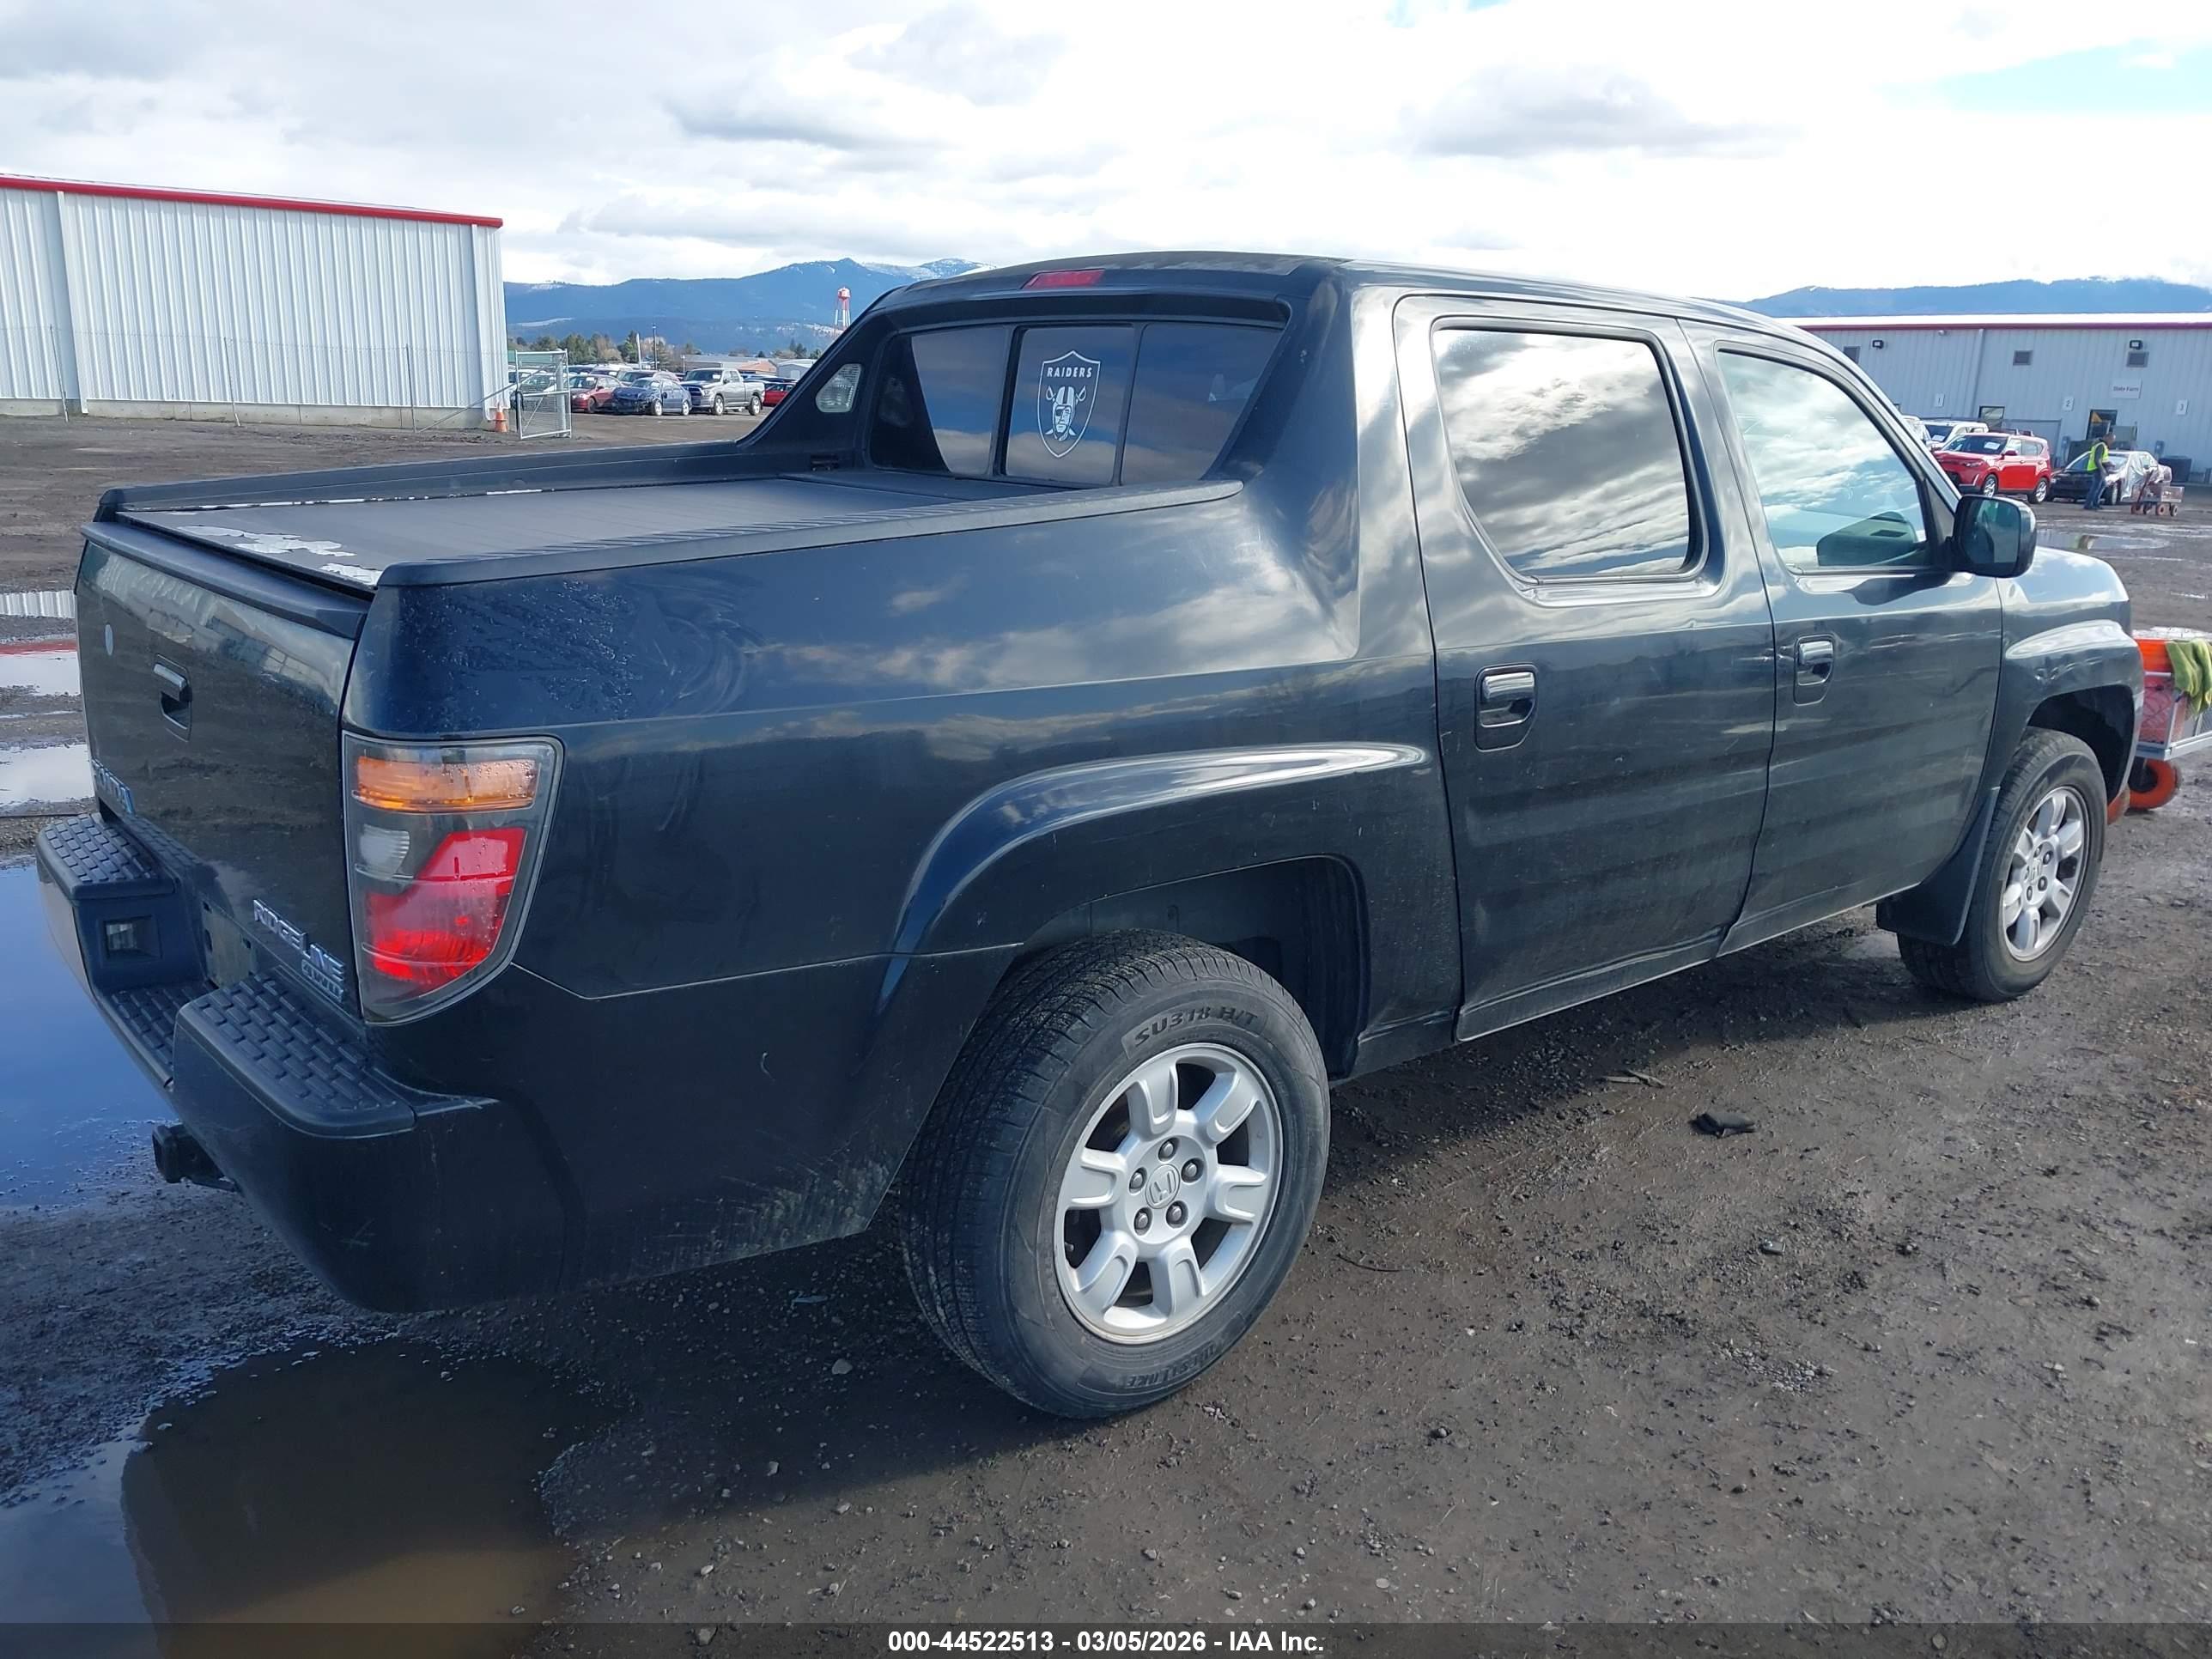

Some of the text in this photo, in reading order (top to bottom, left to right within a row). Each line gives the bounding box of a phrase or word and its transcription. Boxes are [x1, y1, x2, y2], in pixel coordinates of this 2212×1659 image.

[1047, 367, 1093, 378] RAIDERS
[253, 899, 343, 981] RIDGELINE
[1134, 1006, 1211, 1048] SU318
